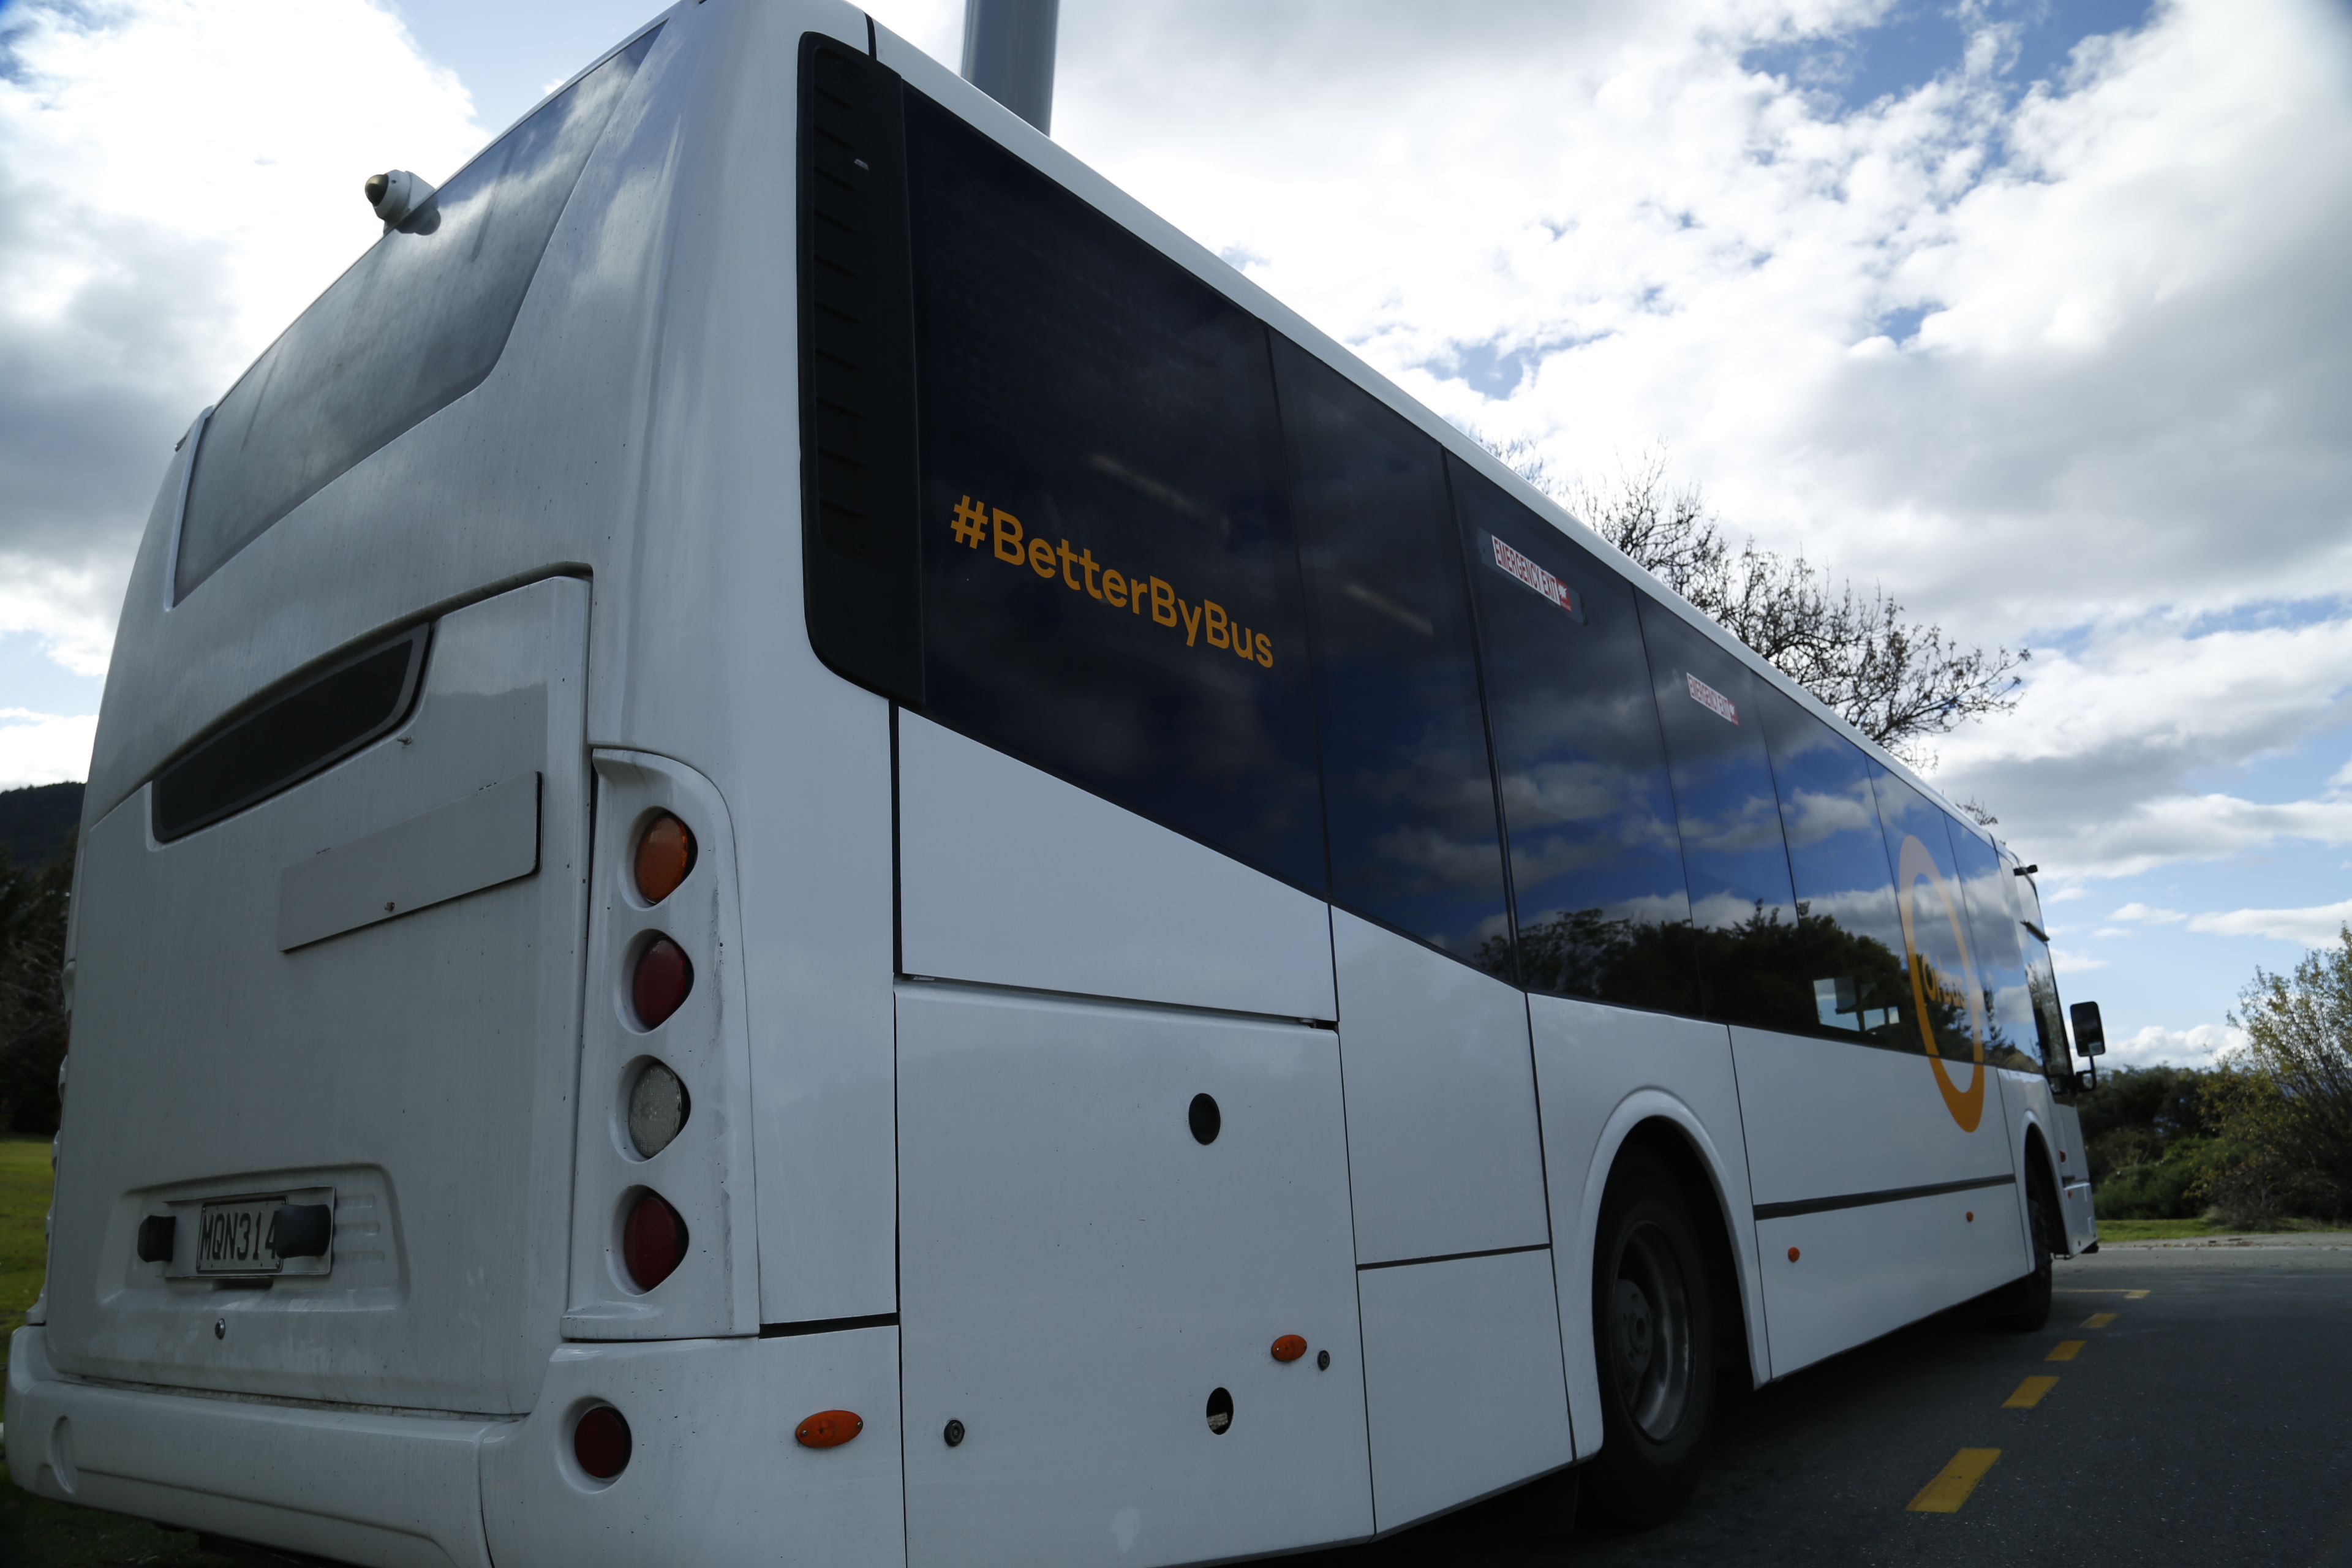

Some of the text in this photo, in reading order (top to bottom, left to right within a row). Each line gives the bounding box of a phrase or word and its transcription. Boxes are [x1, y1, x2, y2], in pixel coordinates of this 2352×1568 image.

[951, 494, 1273, 668] #BetterByBus
[1494, 538, 1558, 601] EMERGENCY EXIT
[201, 1210, 277, 1261] MQN314
